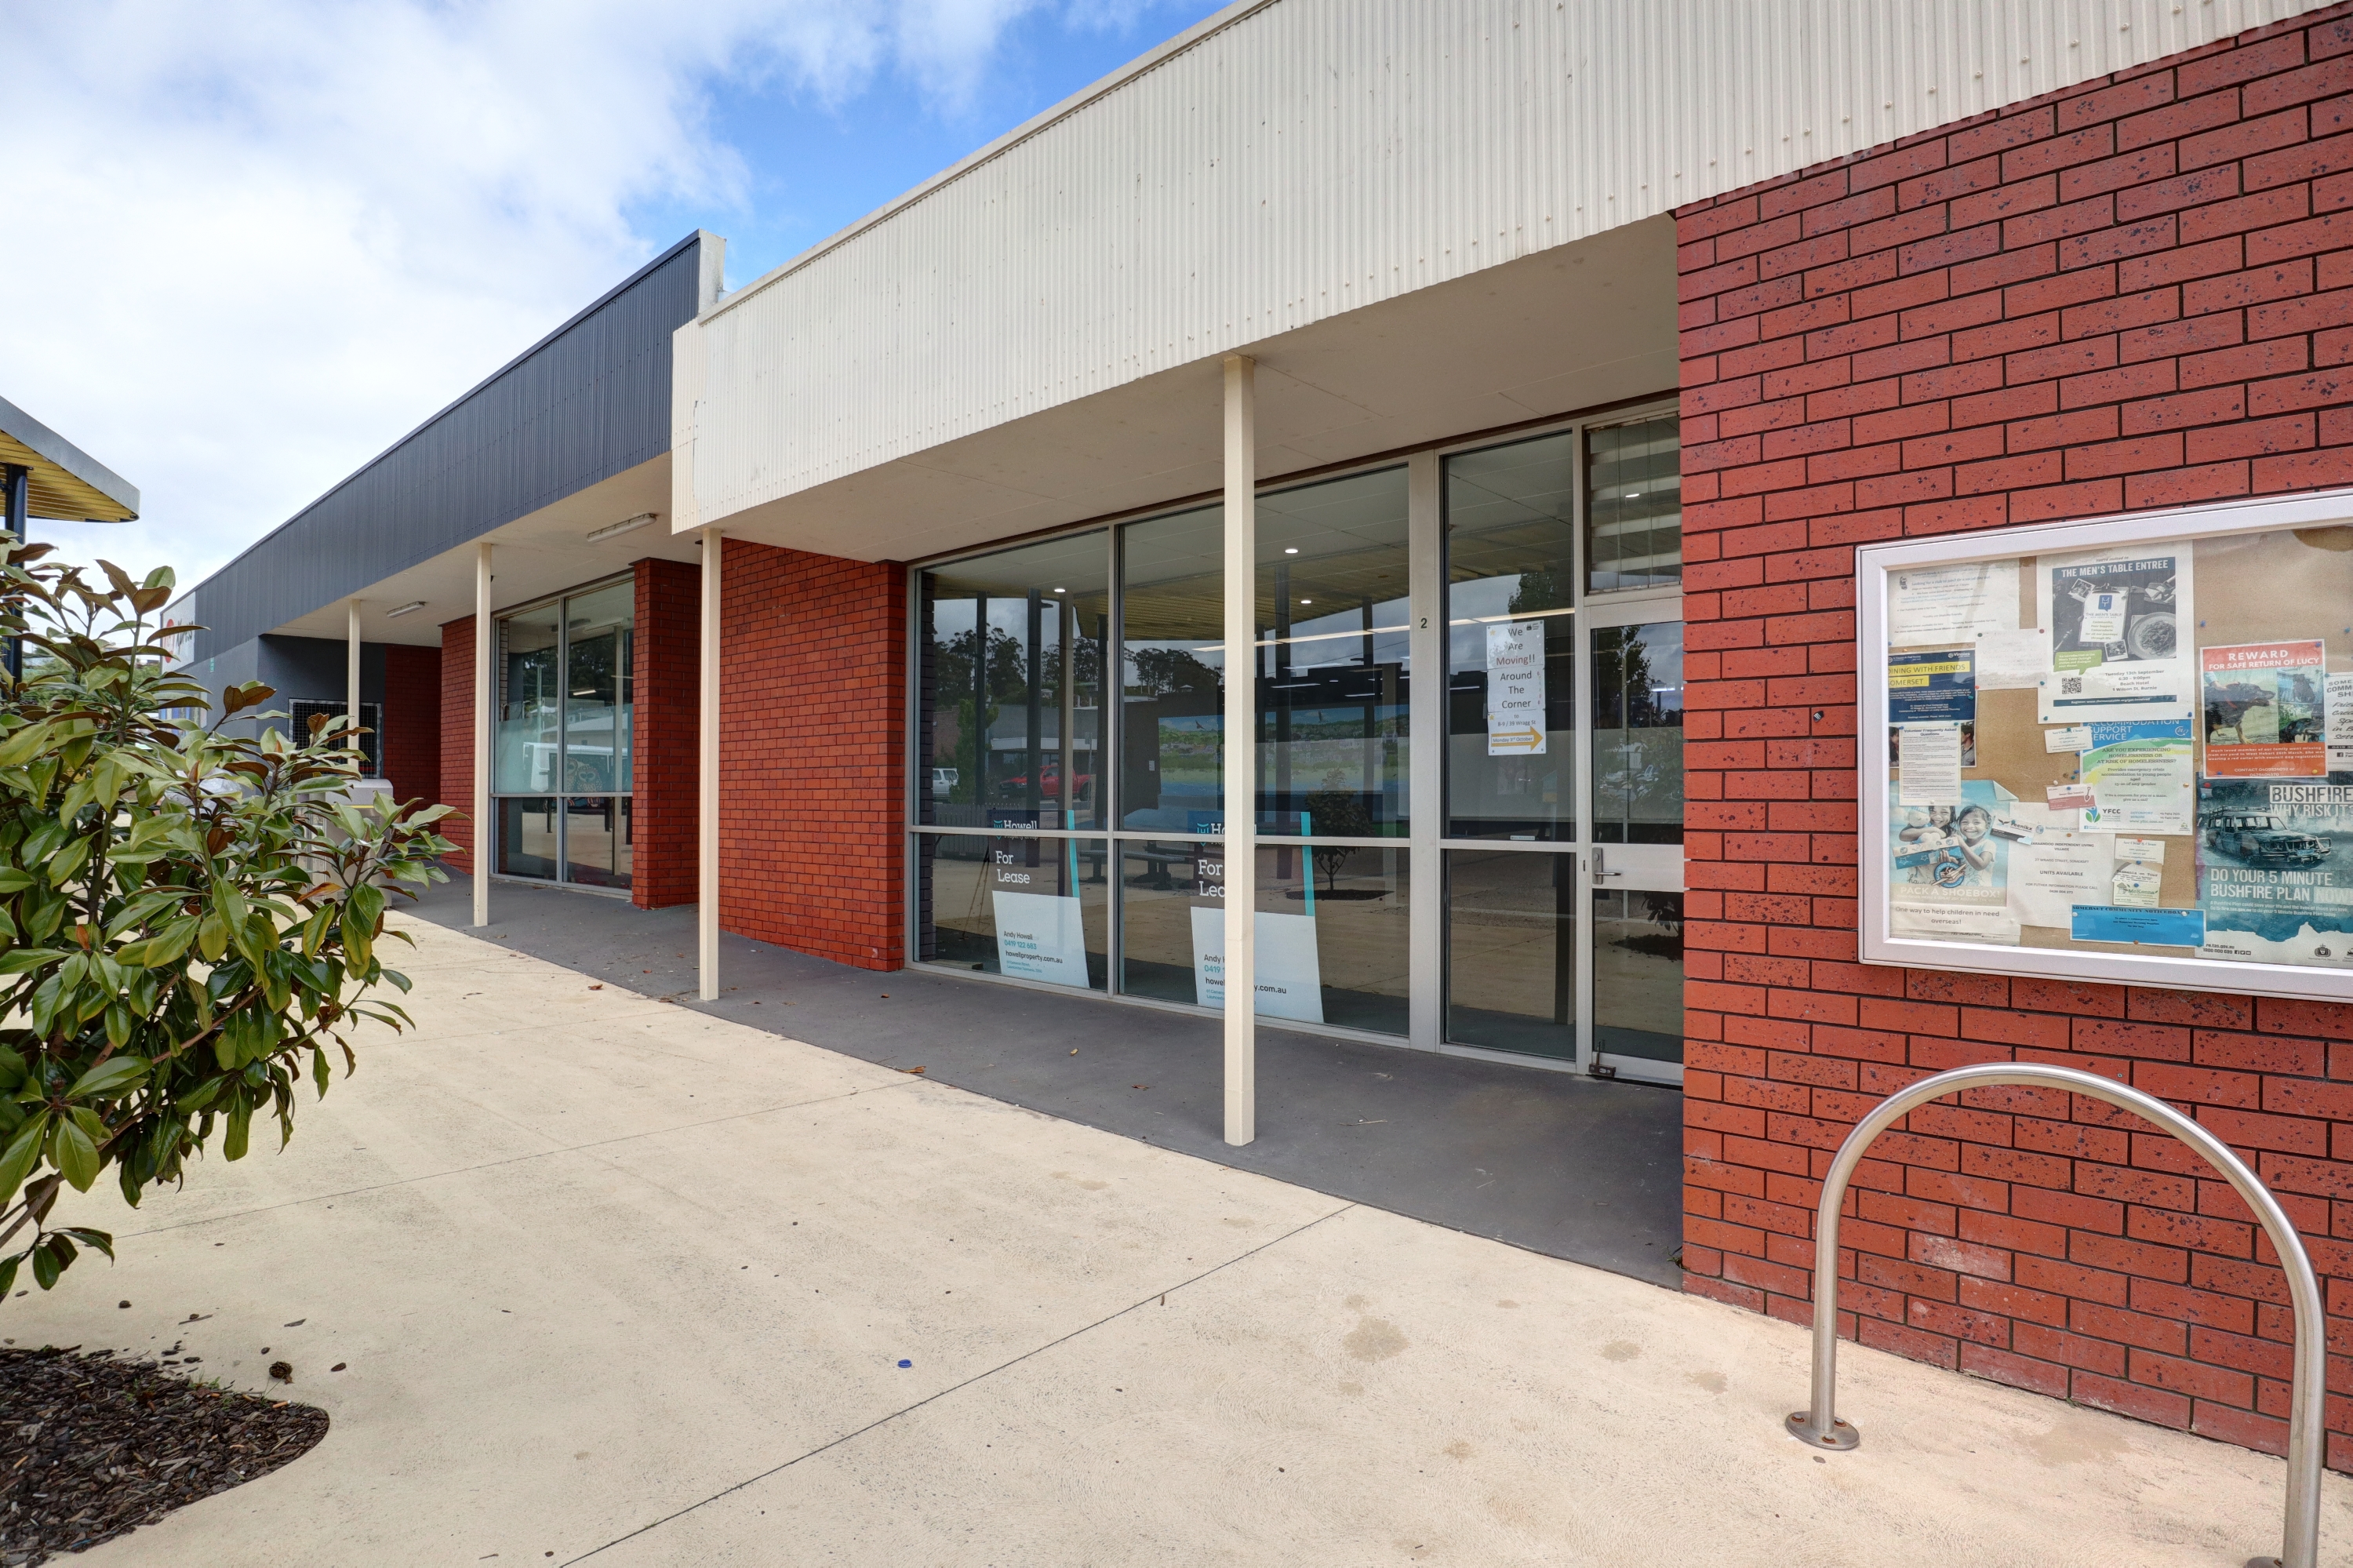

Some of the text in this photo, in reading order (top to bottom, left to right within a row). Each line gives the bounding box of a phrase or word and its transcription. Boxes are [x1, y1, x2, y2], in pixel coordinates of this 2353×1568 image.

[2062, 560, 2168, 577] THE MEN'S TABLE ENTREE
[1421, 618, 1427, 628] 2
[1496, 654, 1534, 665] Moving!!
[2229, 650, 2288, 661] REWARD
[2249, 660, 2281, 668] RETURN
[1500, 671, 1531, 681] Around
[1508, 686, 1524, 694] The
[2272, 787, 2353, 802] BUSHFIRE
[2270, 804, 2299, 817] WHY
[2303, 805, 2332, 817] RISK
[1004, 820, 1037, 829] Howell
[995, 850, 1013, 864] For
[1198, 860, 1223, 875] For
[997, 869, 1031, 883] Lease
[2210, 868, 2333, 886] DO YOUR 5 MINUTE
[1942, 889, 2000, 898] SHOEBOX!
[2210, 883, 2273, 899] BUSHFIRE
[2277, 886, 2310, 901] PLAN
[1006, 950, 1063, 963] howellproperty.com.au
[1204, 954, 1221, 964] Andy
[1204, 964, 1220, 973] 0419
